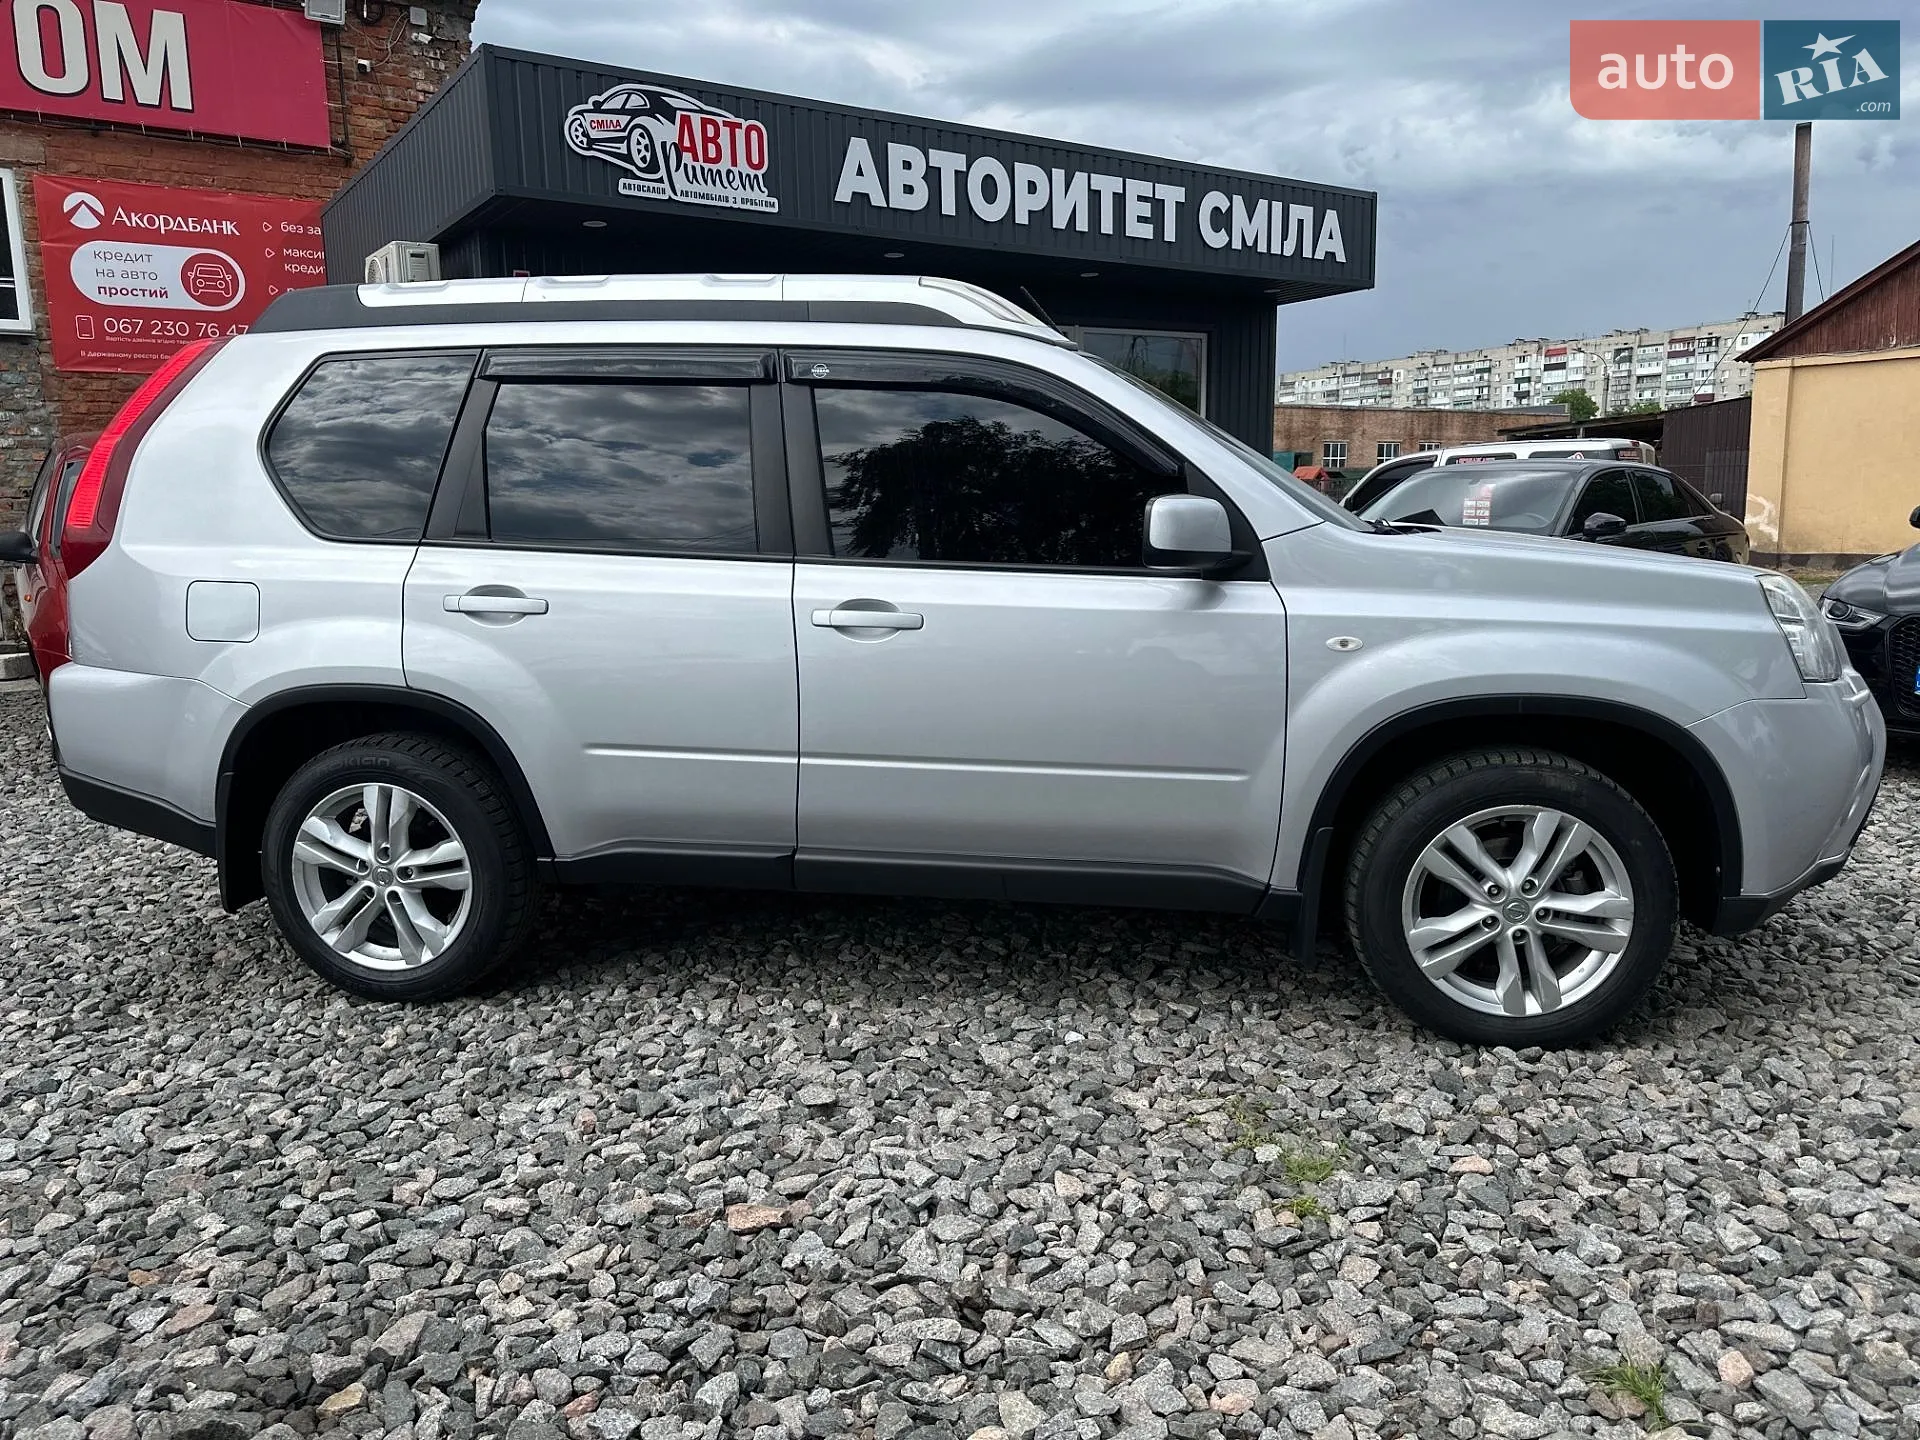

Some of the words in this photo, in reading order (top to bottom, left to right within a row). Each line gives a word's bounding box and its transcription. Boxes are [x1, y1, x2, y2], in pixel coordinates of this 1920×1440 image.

[589, 119, 622, 130] СМІЛА
[676, 113, 766, 171] АВТО
[622, 182, 667, 196] АВТОСАЛОН
[679, 189, 730, 204] АВТОМОБІЛІВ
[740, 197, 776, 209] ПРОБІГОМ
[834, 136, 1186, 242] АВТОРИТЕТ
[1199, 189, 1347, 263] СМІЛА
[280, 221, 304, 234] без
[93, 250, 153, 263] кредит
[95, 268, 115, 278] на
[120, 270, 158, 281] авто
[284, 263, 326, 275] креди
[97, 285, 169, 299] простий
[103, 317, 144, 335] 067
[151, 320, 190, 337] 230
[195, 322, 220, 338] 76
[226, 324, 249, 336] 47
